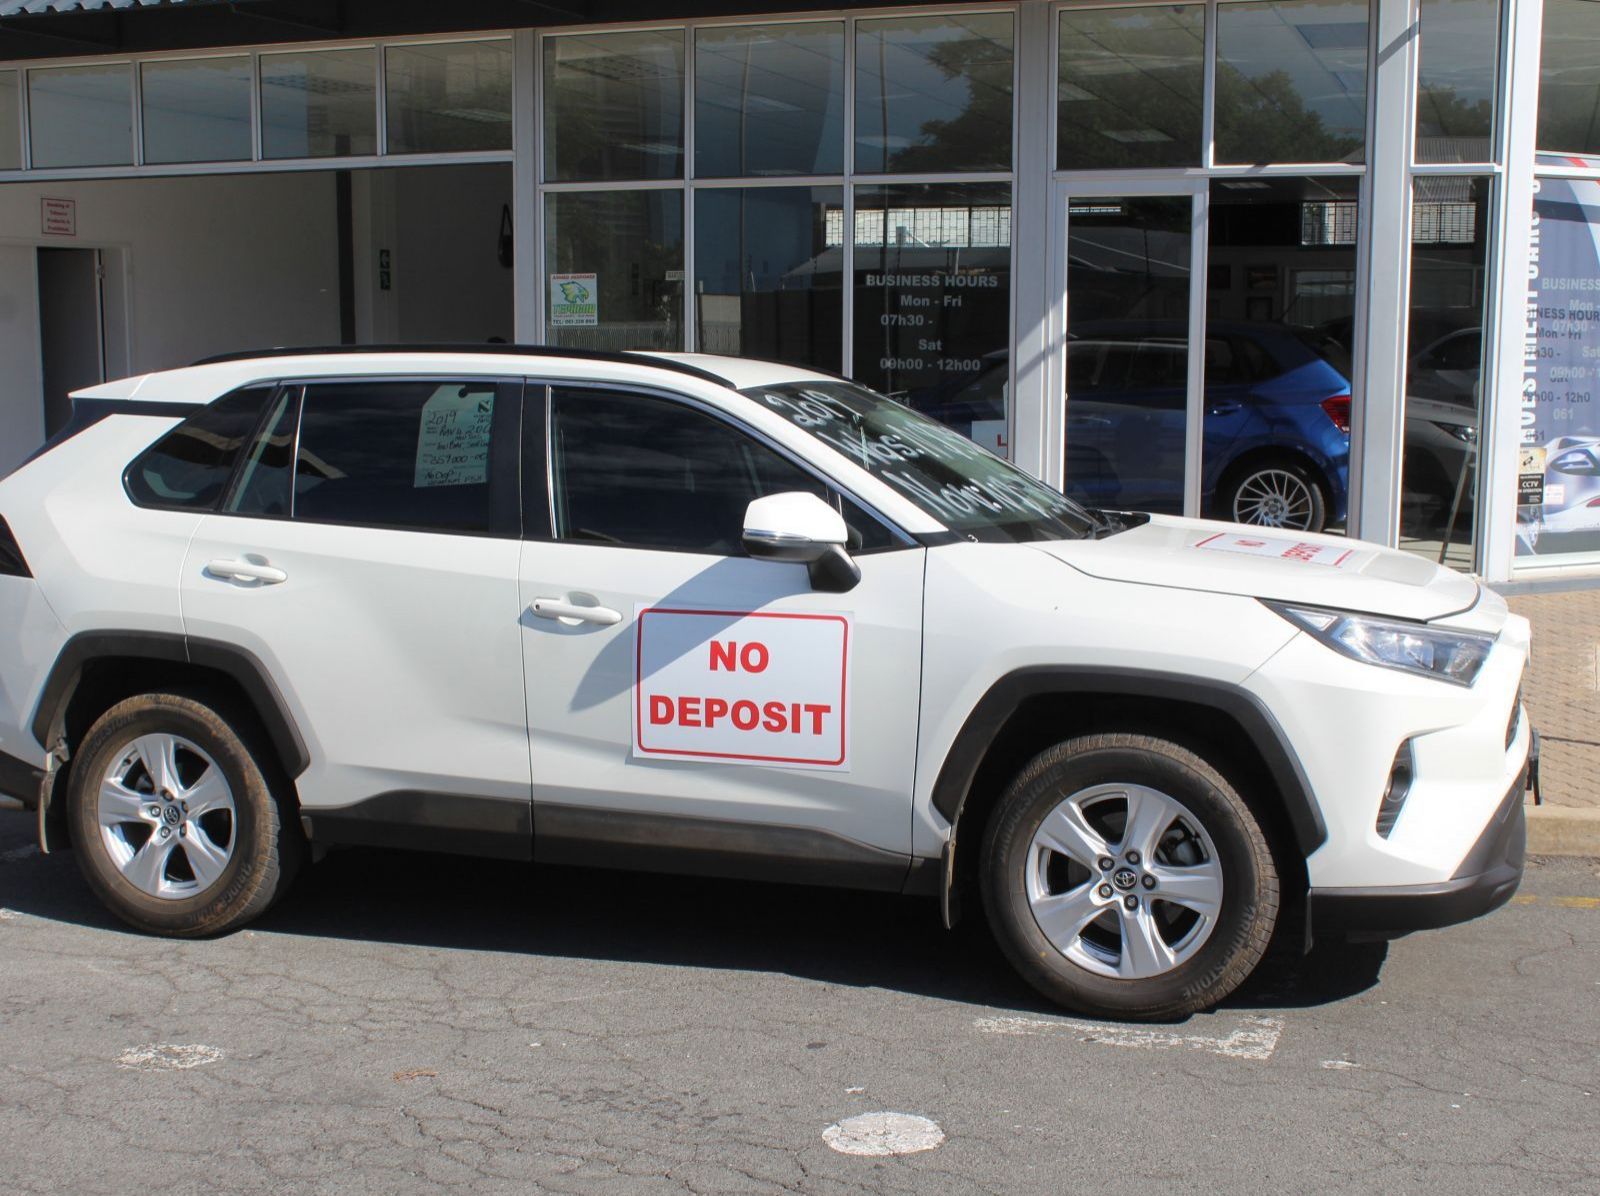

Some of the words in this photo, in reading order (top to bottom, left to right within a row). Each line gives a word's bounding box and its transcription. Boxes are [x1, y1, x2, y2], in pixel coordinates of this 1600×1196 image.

[865, 274, 940, 287] BUSINESS
[944, 275, 998, 288] HOURS
[900, 295, 930, 306] Mon
[943, 295, 962, 307] Fri
[880, 314, 924, 326] 07h30
[918, 339, 942, 351] Sat
[937, 359, 981, 371] 12h00
[709, 640, 769, 674] NO
[649, 694, 831, 736] DEPOSIT
